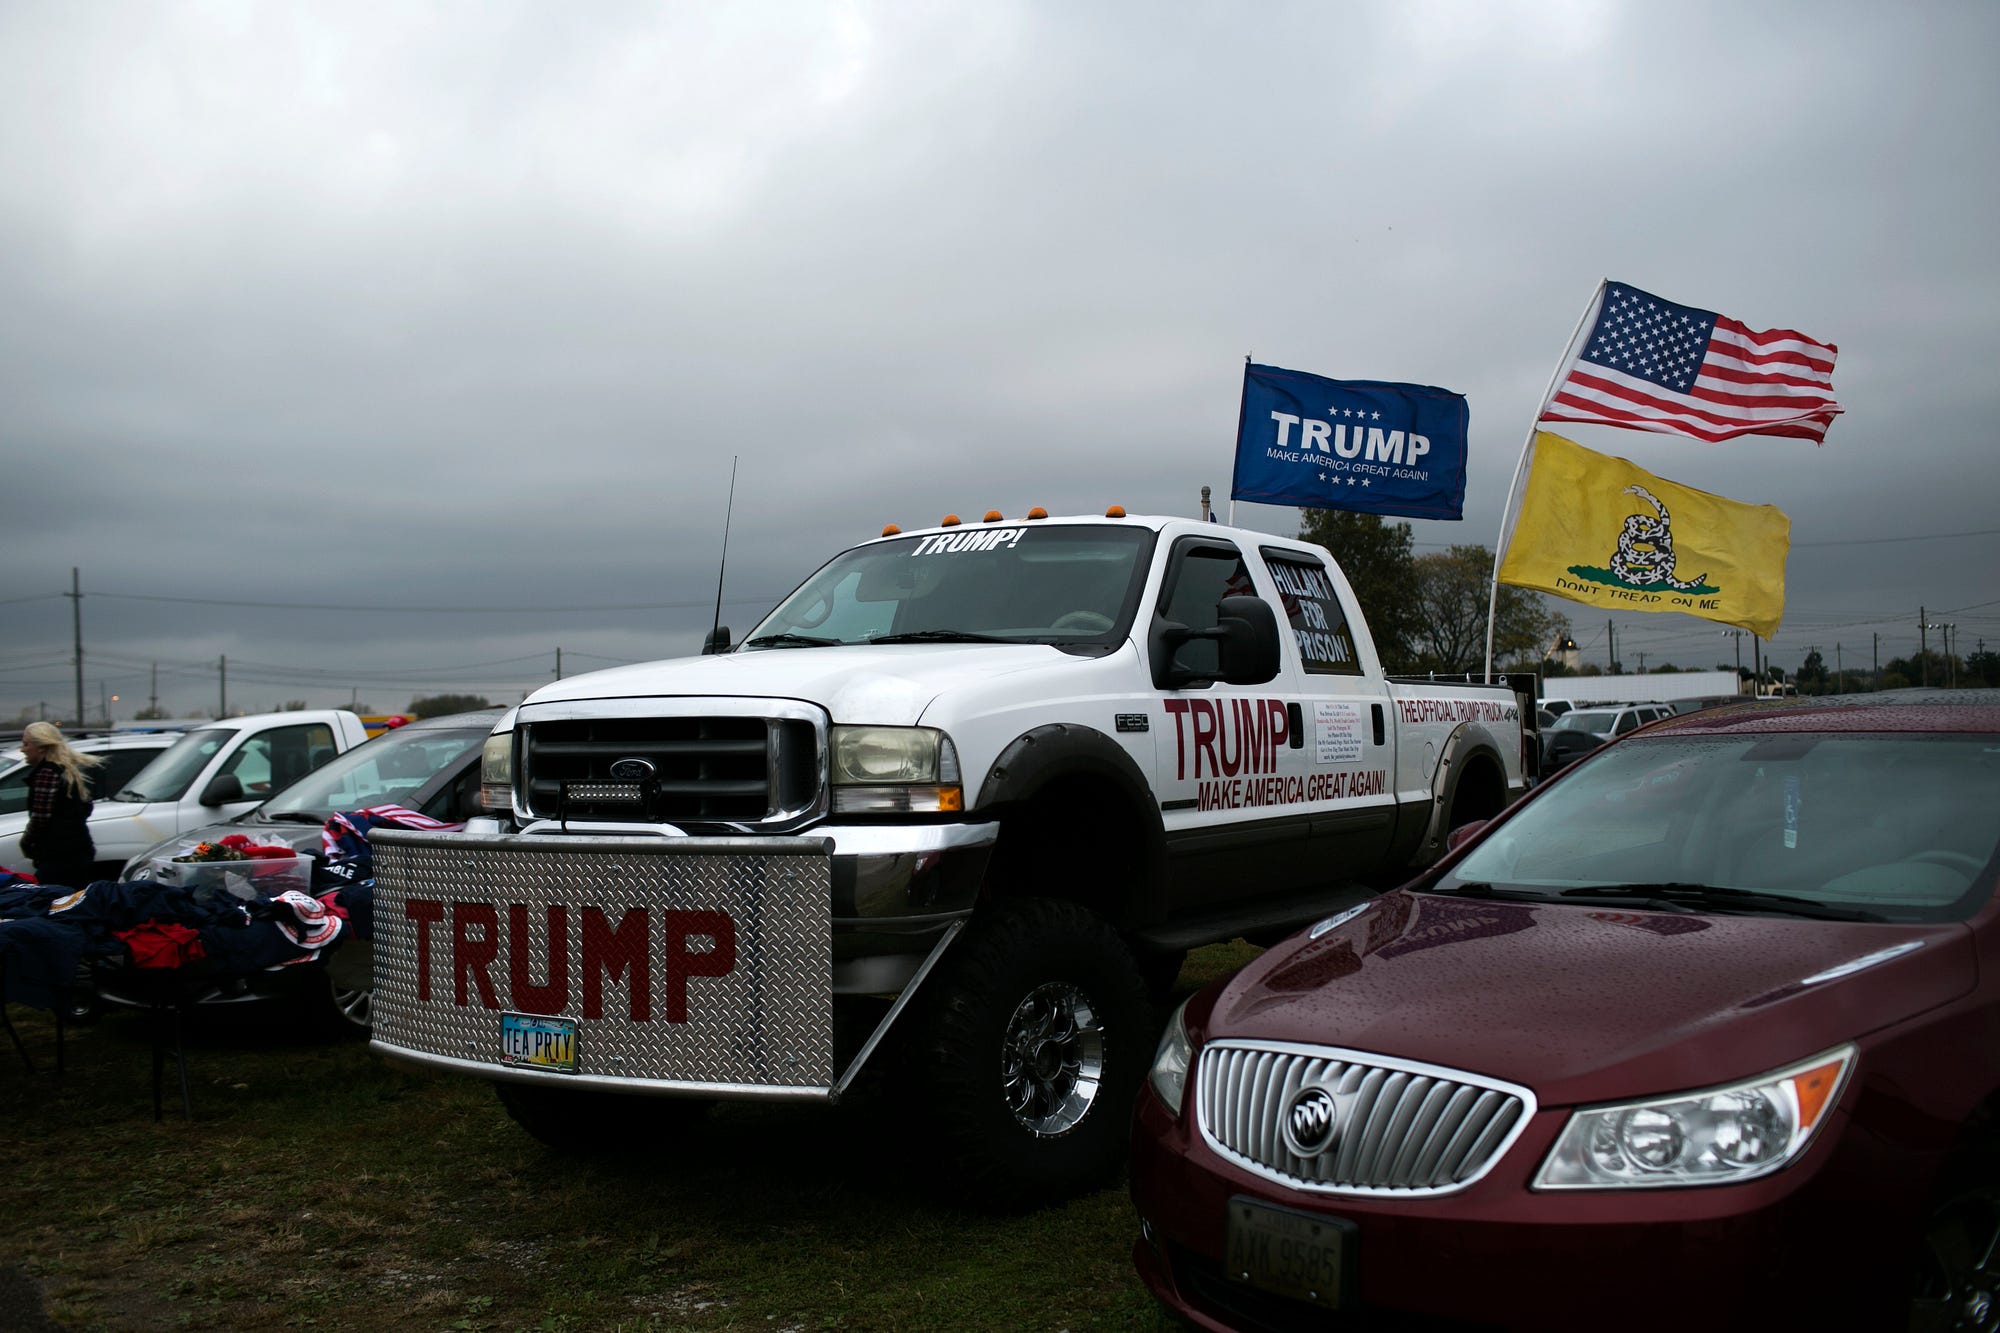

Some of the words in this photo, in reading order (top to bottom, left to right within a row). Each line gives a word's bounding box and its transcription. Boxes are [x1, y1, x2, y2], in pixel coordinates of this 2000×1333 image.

[1270, 410, 1431, 466] TRUMP
[1266, 447, 1300, 463] MAKE
[1300, 453, 1351, 472] AMERICA
[1352, 462, 1392, 477] GREAT
[1392, 468, 1429, 482] AGAIN!
[911, 527, 1028, 557] TRUMP!
[1266, 561, 1332, 600] HILLARY
[1555, 577, 1601, 595] DONT
[1608, 589, 1662, 603] TREAD
[1671, 597, 1693, 608] ON
[1699, 599, 1721, 610] ME
[1298, 599, 1329, 631] FOR
[1292, 628, 1351, 663] PRISON!
[1453, 700, 1480, 722] TRUMP
[1479, 701, 1504, 722] TRUCK
[1163, 698, 1290, 781] TRUMP
[1197, 780, 1241, 812] MAKE
[1243, 776, 1304, 808] AMERICA
[1307, 773, 1348, 802] GREAT
[1349, 769, 1386, 798] AGAIN!
[405, 899, 736, 1025] TRUMP
[505, 1027, 530, 1056] TEA
[535, 1031, 571, 1061] PRTY
[1231, 1226, 1272, 1274] AXK
[1279, 1237, 1336, 1288] 9585
